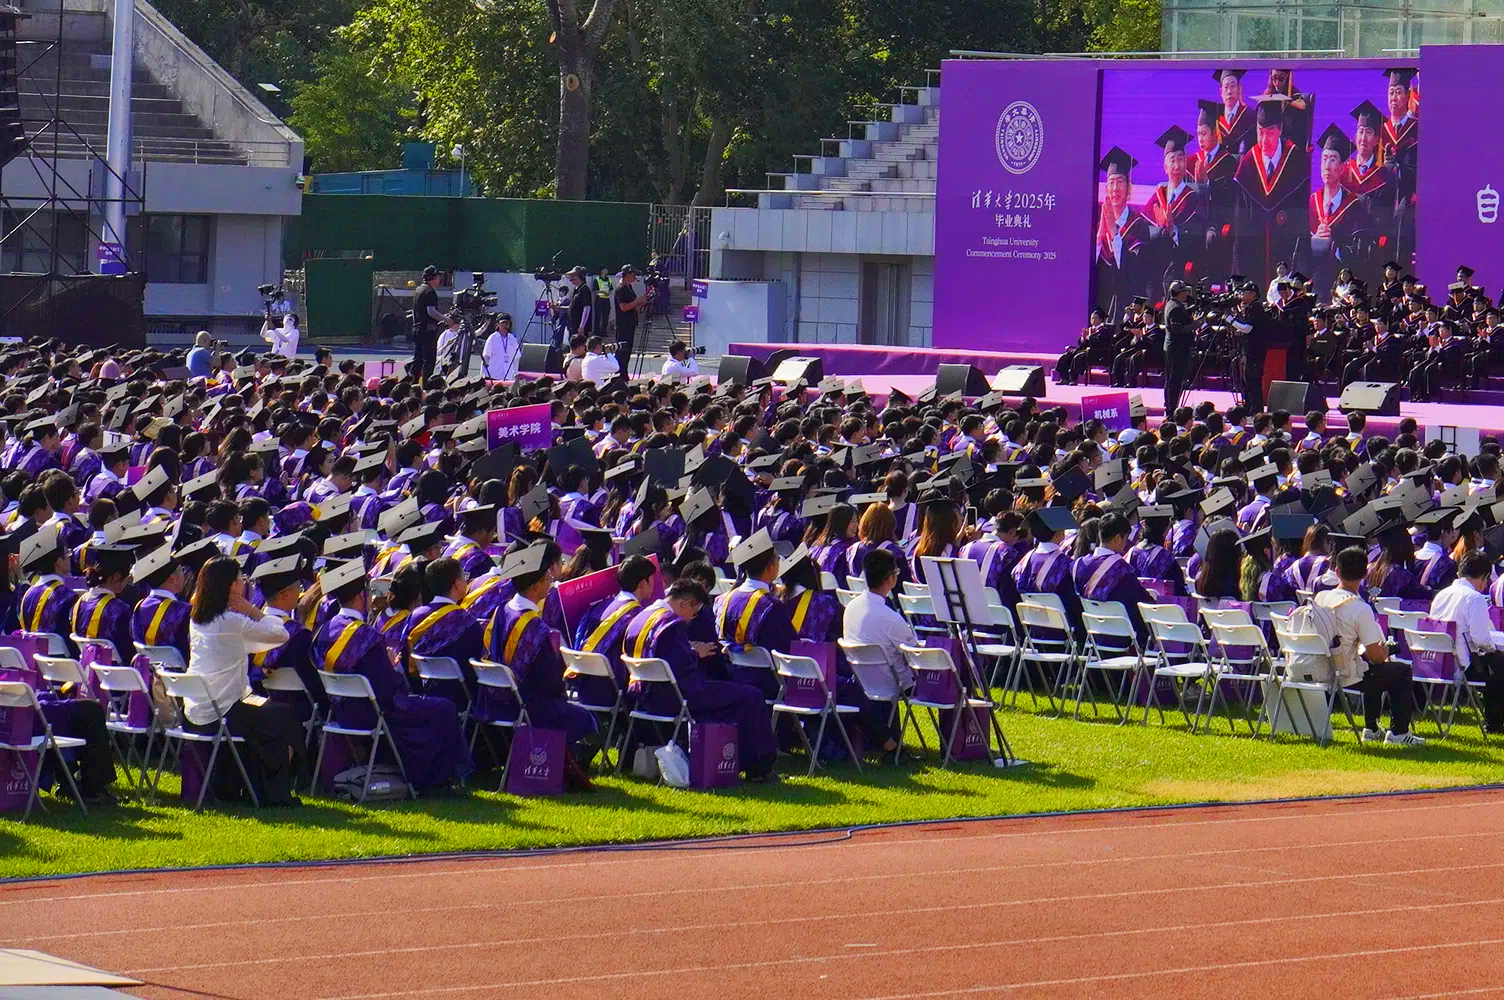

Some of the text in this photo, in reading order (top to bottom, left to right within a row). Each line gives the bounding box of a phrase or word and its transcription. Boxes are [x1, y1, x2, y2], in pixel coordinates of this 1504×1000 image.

[995, 213, 1032, 228] 毕业典礼
[982, 237, 1039, 248] Tsinghua University
[966, 249, 1057, 260] Commencement Ceremony 2025
[1094, 407, 1119, 420] 机械系
[497, 421, 542, 439] 美术学院
